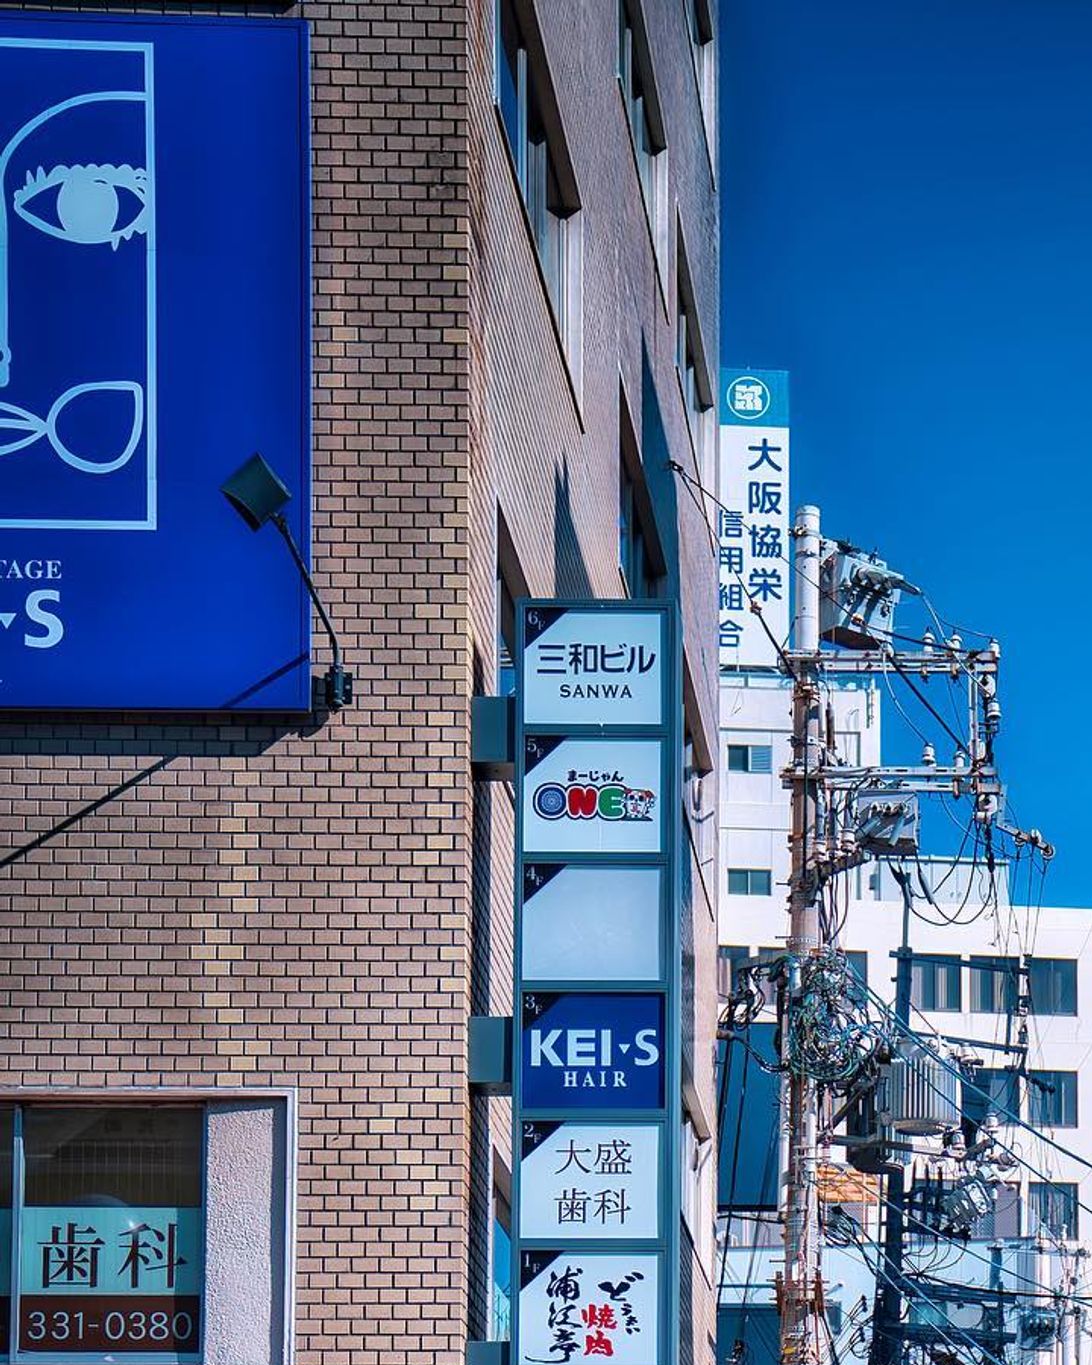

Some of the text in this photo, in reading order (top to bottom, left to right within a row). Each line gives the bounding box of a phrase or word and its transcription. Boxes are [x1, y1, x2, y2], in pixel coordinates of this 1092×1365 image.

[748, 438, 783, 601] 大阪協栄
[719, 510, 745, 648] 信用組合
[527, 609, 546, 631] 6F
[537, 642, 656, 675] 三和ビル
[559, 683, 633, 700] SANWA
[527, 738, 545, 759] 5F
[567, 770, 624, 783] まーじゃん
[533, 783, 625, 821] ONE
[525, 866, 544, 887] 4F
[563, 1071, 628, 1088] HAIR
[554, 1138, 633, 1176] 大盛
[554, 1188, 632, 1225] 歯科
[37, 1222, 188, 1289] 歯科
[27, 1311, 193, 1340] 331-0380
[581, 1303, 618, 1357] 焼肉
